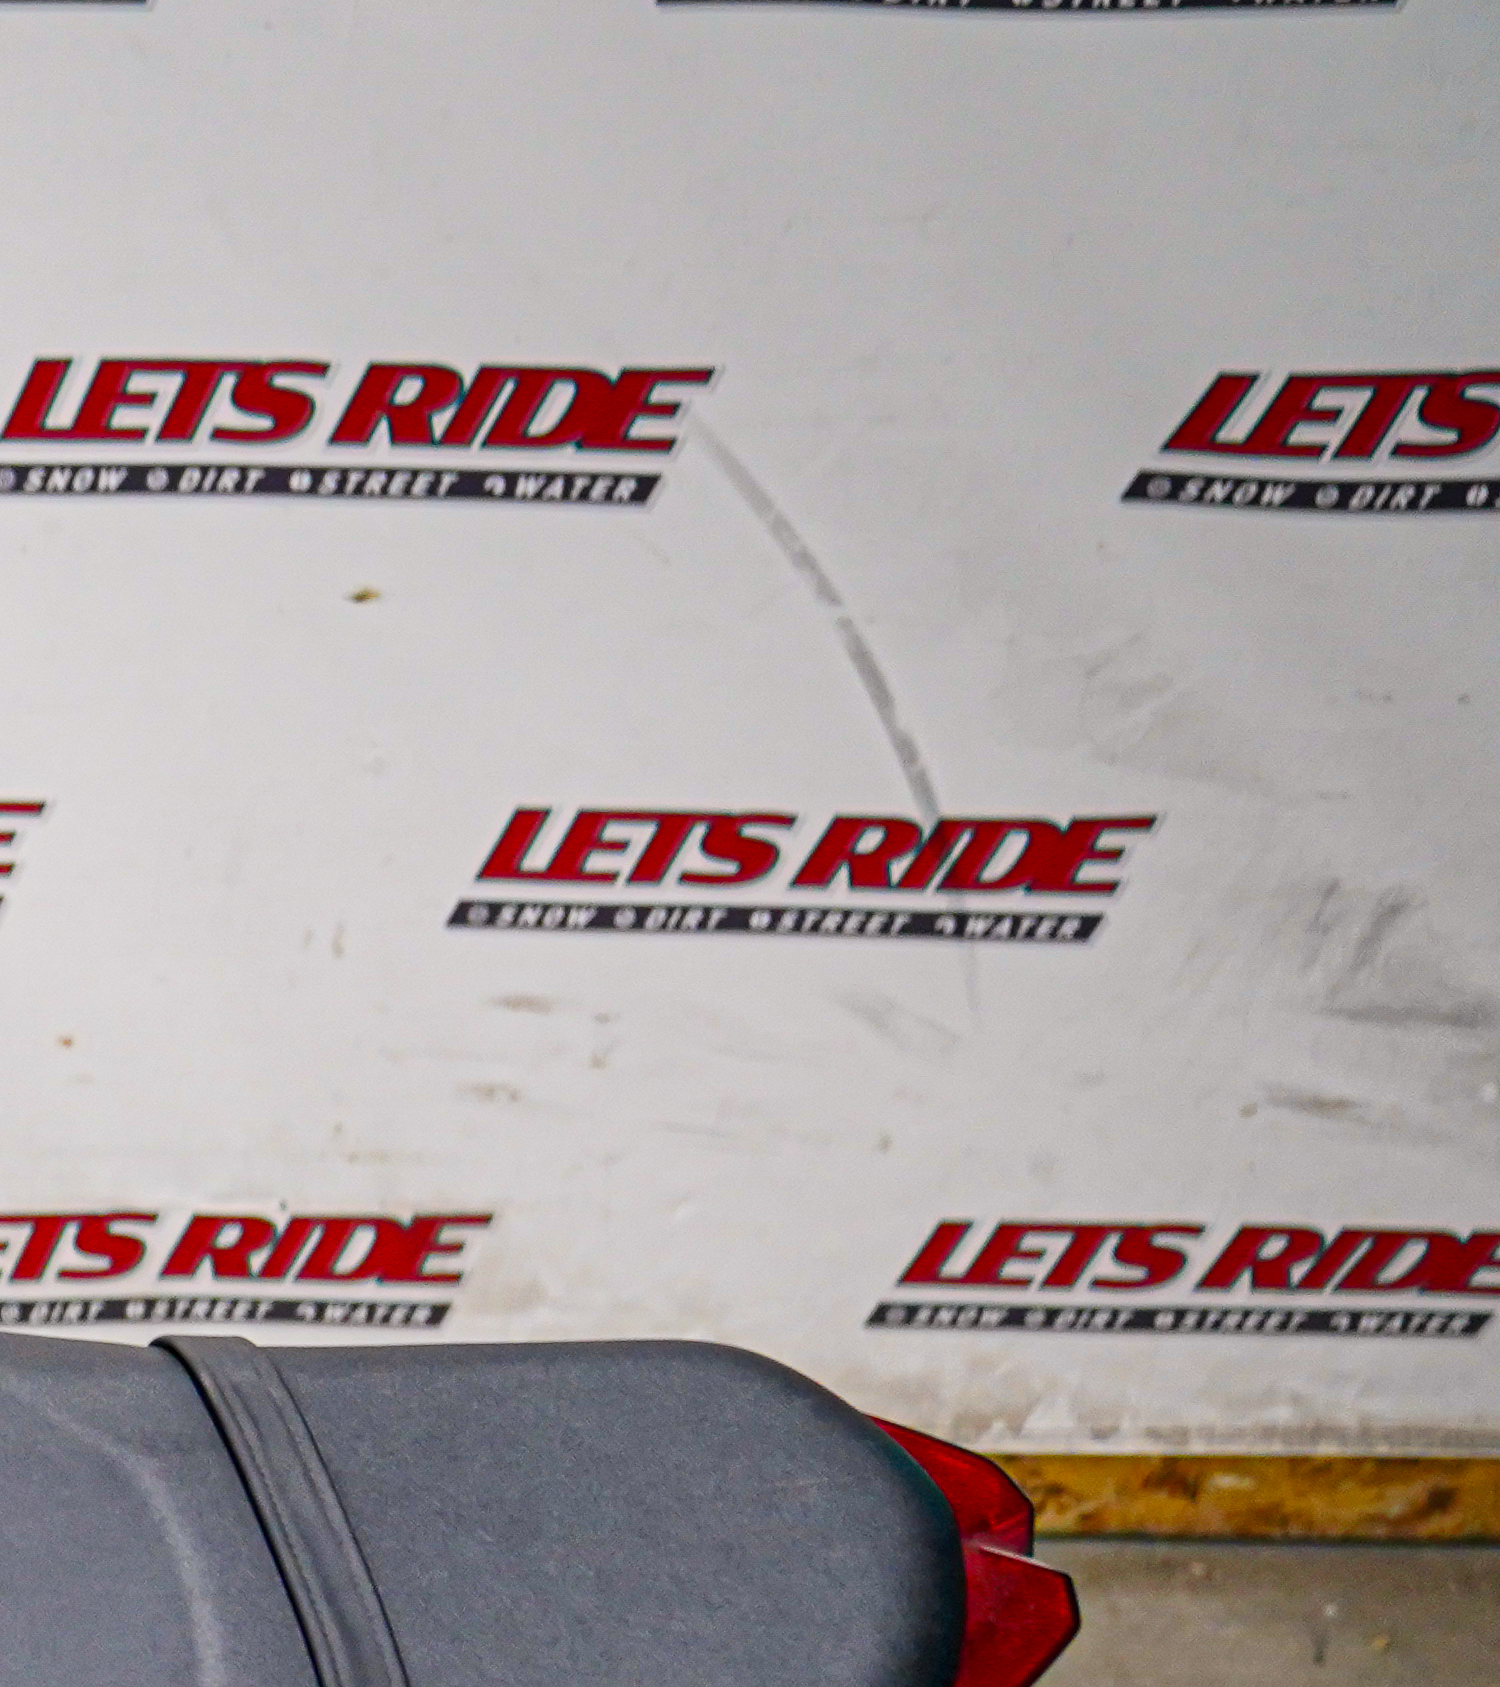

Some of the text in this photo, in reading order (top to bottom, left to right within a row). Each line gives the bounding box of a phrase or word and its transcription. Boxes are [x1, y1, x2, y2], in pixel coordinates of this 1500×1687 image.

[2, 359, 712, 452] LETS RIDE
[1162, 371, 1500, 459] LETS
[23, 467, 637, 502] SNOW DIRT STREET WATER
[1178, 477, 1443, 510] SNOW DIRT
[476, 808, 1158, 894] LETS RIDE
[496, 905, 1082, 939] SNOW DIRT STREET WATER
[164, 1214, 494, 1284] RIDE
[900, 1222, 1500, 1296] LETS RIDE
